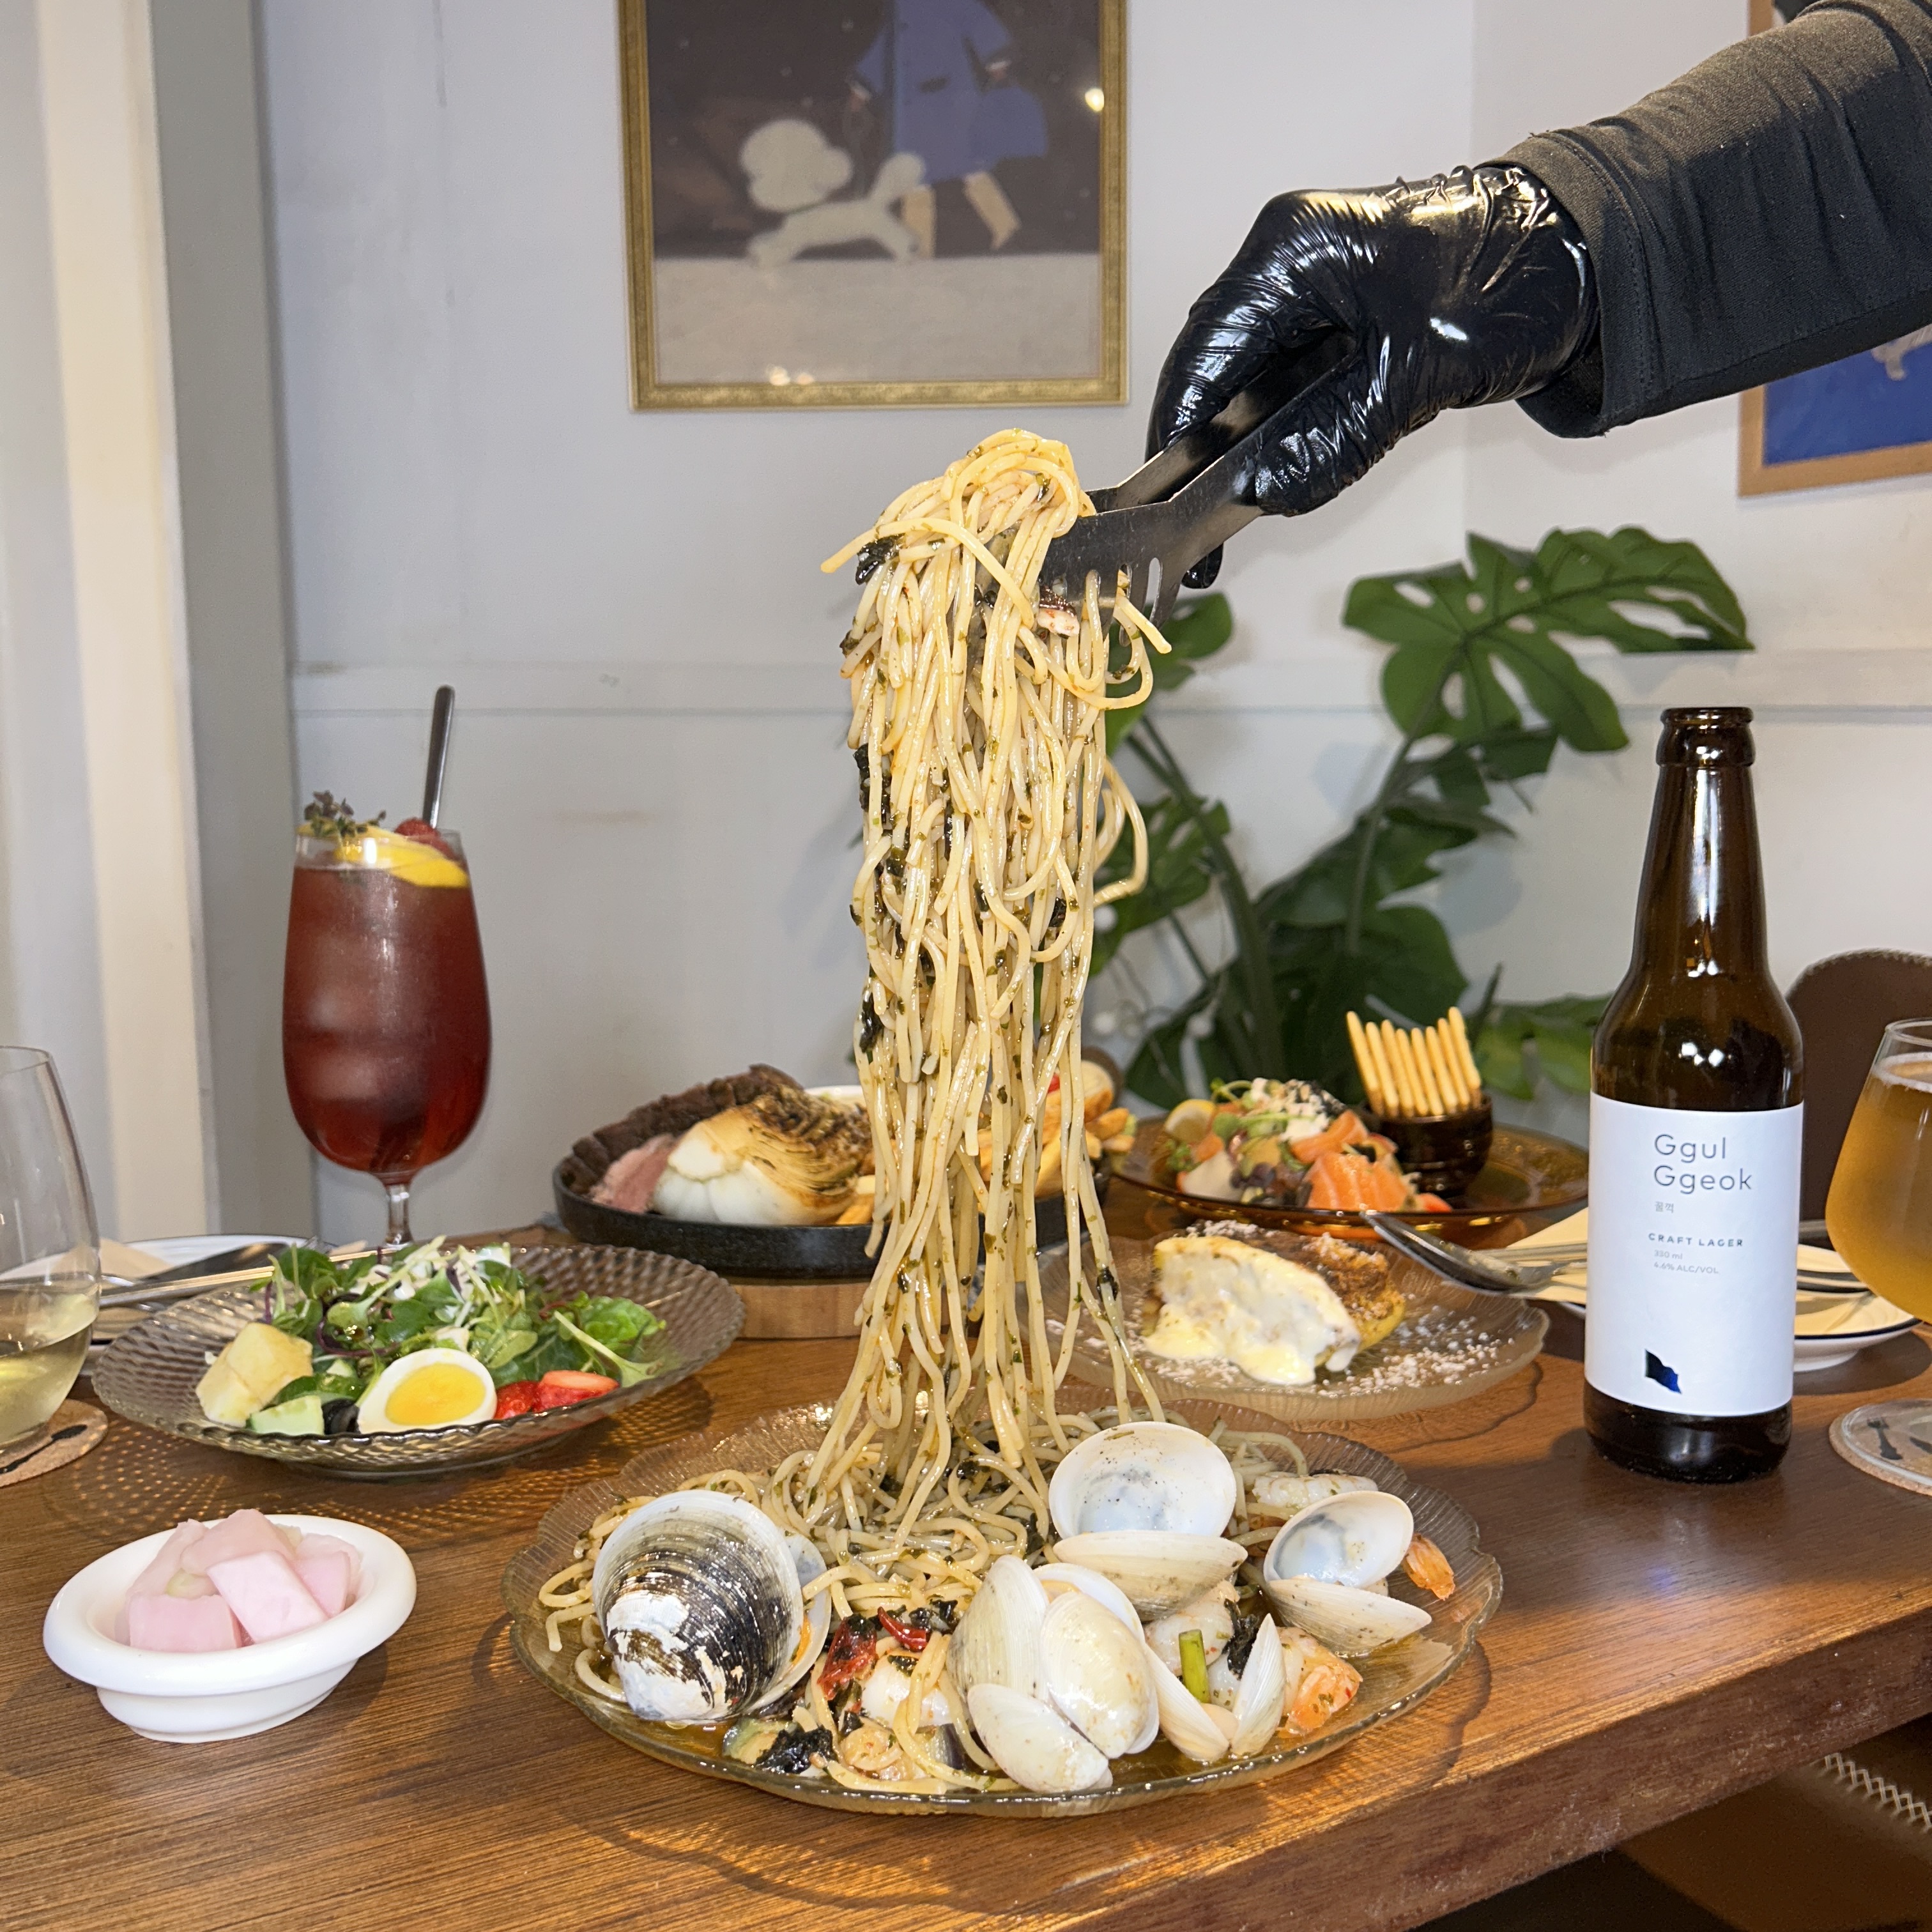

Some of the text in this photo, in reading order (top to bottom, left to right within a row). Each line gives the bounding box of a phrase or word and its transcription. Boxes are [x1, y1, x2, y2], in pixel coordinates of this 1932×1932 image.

[1654, 1133, 1726, 1163] Ggul
[1653, 1165, 1752, 1194] Ggeok
[1648, 1232, 1744, 1247] CRAFT LAGER
[1654, 1250, 1670, 1259] 330
[1676, 1264, 1719, 1274] ALC/VOL
